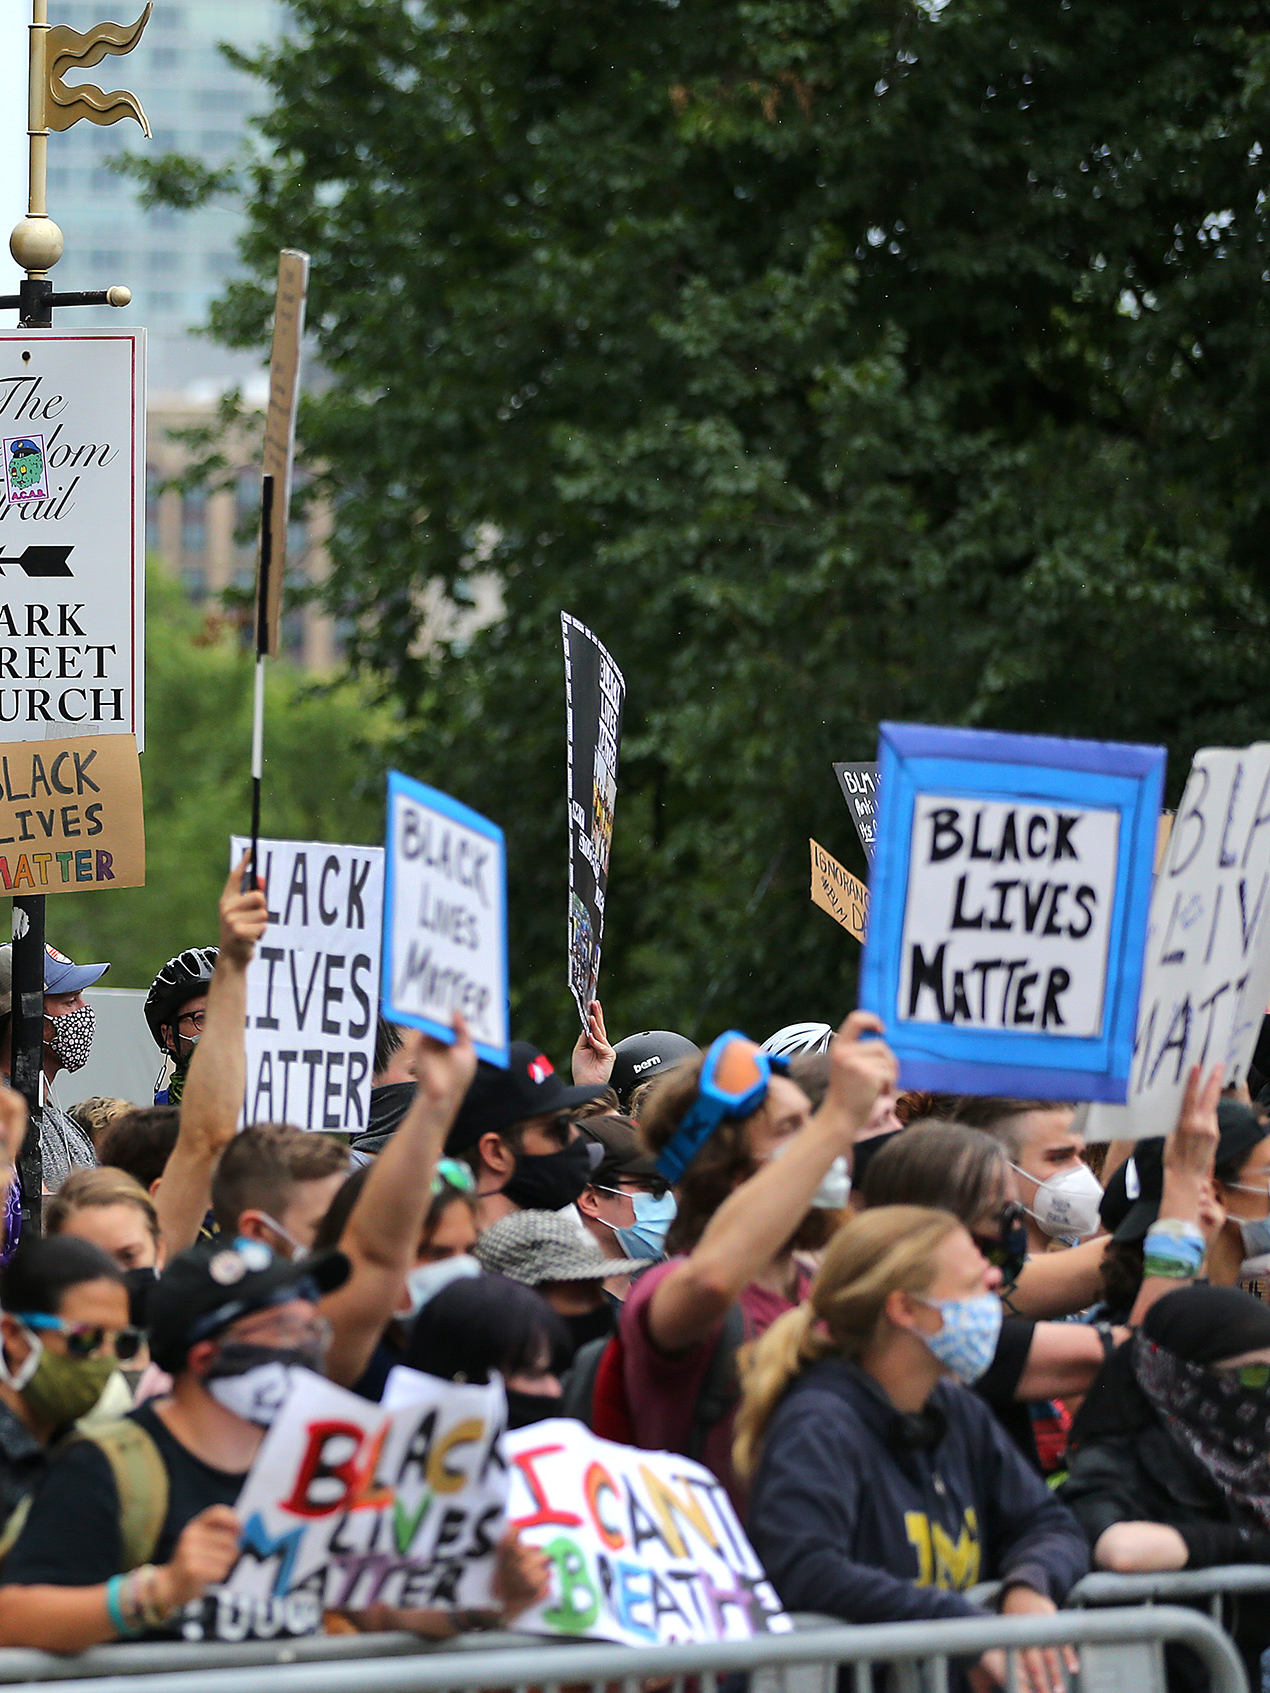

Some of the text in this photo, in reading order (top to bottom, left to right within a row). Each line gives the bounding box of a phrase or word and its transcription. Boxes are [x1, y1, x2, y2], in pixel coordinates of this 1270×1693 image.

[843, 770, 876, 795] BLM
[401, 808, 490, 909] BLACK
[927, 808, 1082, 863] BLACK
[241, 847, 372, 930] LACK
[951, 873, 1096, 938] LIVES
[245, 946, 372, 1040] IVES
[909, 943, 1071, 1029] MATTER
[243, 1049, 369, 1130] ATTER
[278, 1406, 507, 1518] BLACK
[510, 1444, 583, 1527] I
[228, 1512, 465, 1609] MATTER
[328, 1495, 504, 1560] LIVES
